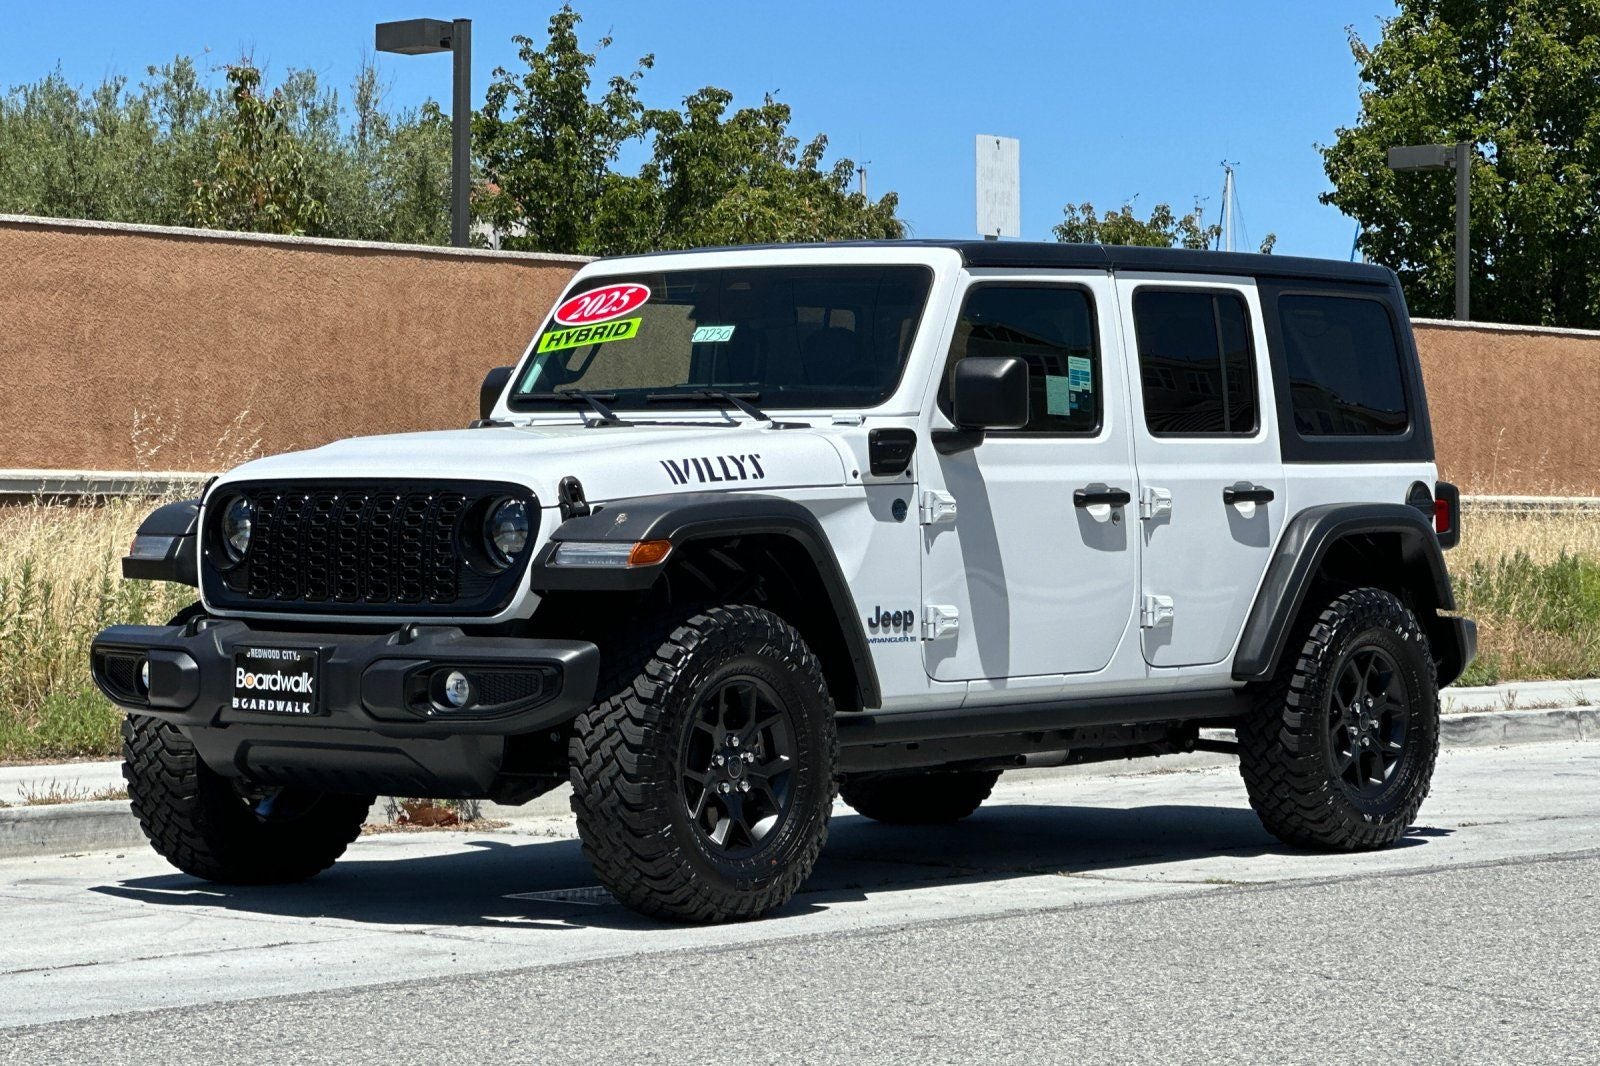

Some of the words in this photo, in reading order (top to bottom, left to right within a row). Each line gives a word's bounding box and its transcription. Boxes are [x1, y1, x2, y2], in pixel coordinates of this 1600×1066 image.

[565, 287, 638, 320] 2025
[545, 321, 632, 348] HYBRID
[659, 453, 765, 485] WILLYS
[867, 605, 914, 631] Jeep
[250, 648, 280, 660] REDWOOD
[282, 650, 297, 660] CITY
[235, 667, 313, 693] Boardwalk
[232, 697, 310, 713] BOARDWALK
